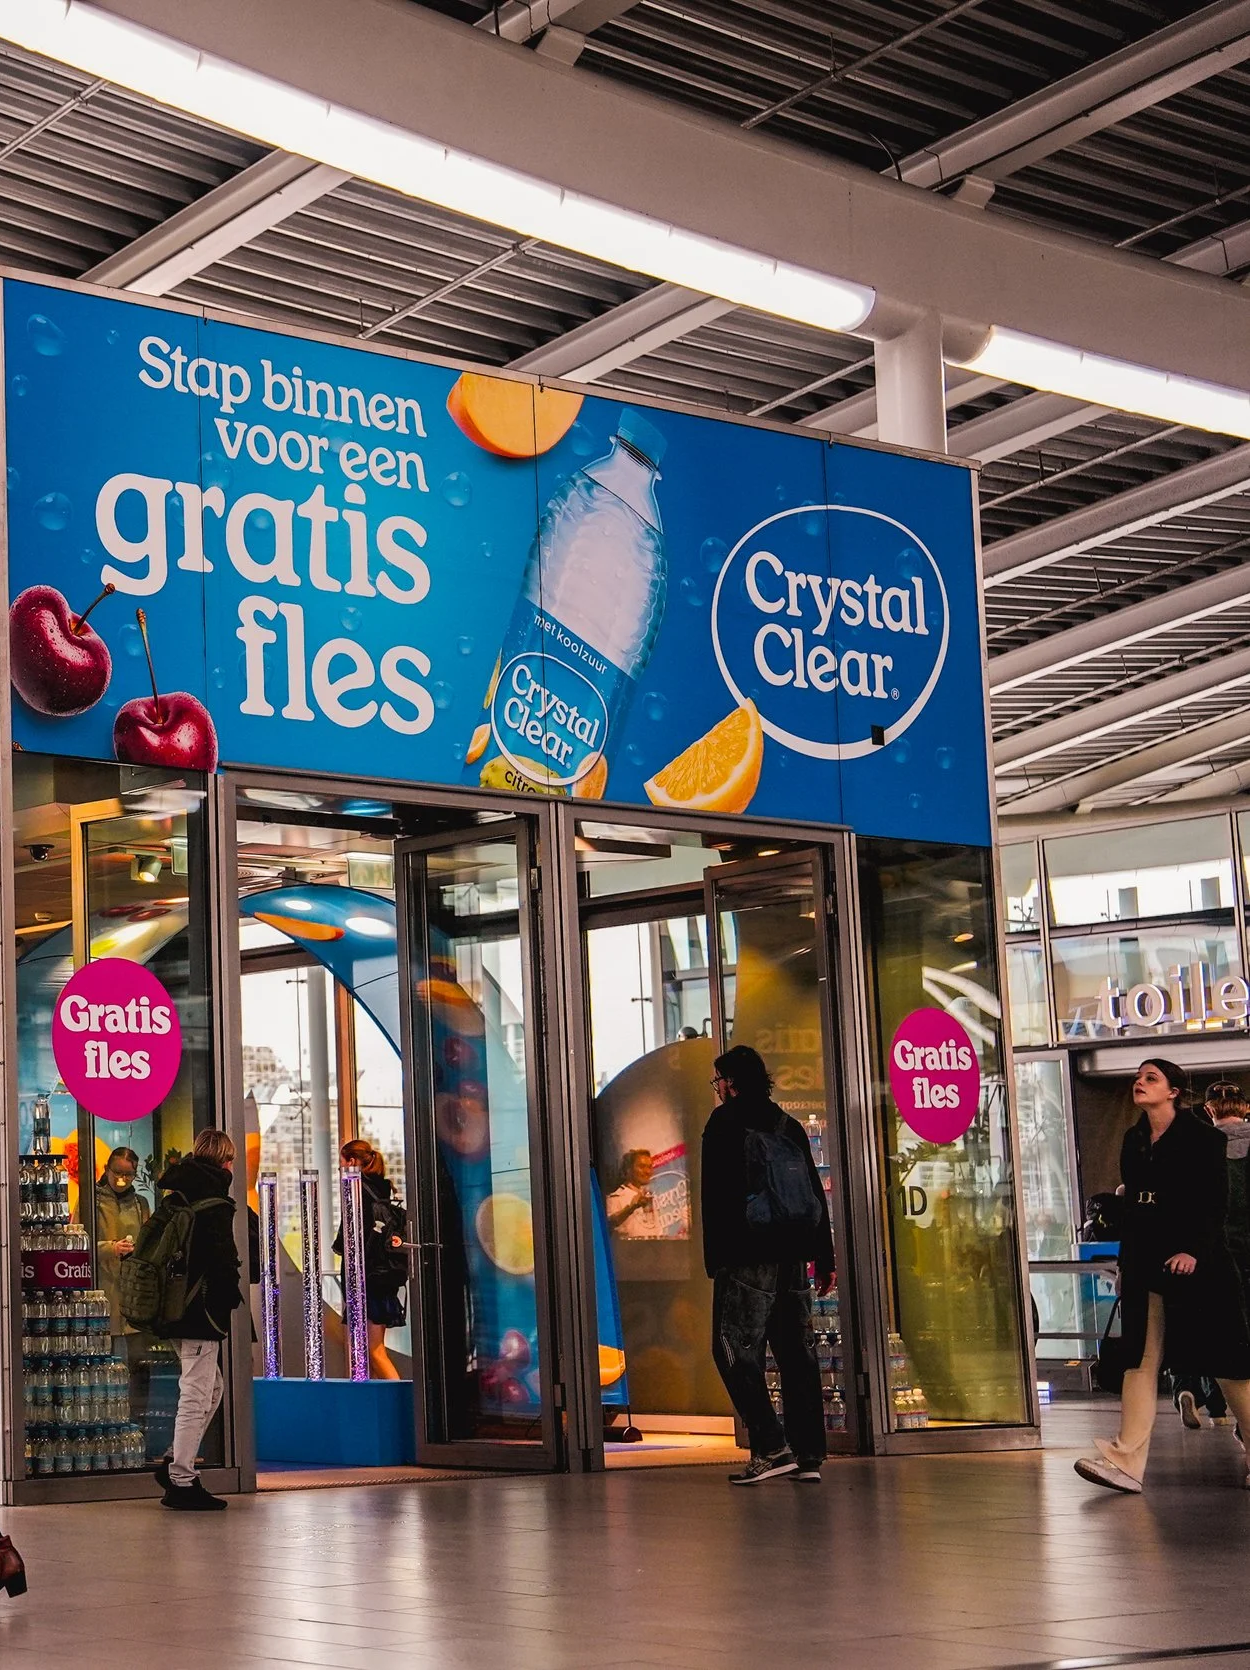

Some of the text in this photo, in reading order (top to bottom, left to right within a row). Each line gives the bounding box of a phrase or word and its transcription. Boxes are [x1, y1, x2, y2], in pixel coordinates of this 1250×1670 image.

[137, 336, 428, 438] Stap binnen
[214, 417, 430, 493] voor een
[95, 473, 431, 605] gratis
[745, 550, 930, 637] Crystal
[236, 595, 435, 735] fles
[533, 613, 608, 675] met koolzuur
[511, 664, 600, 748] Crystal
[60, 994, 172, 1035] Gratis
[84, 1040, 151, 1080] fles
[893, 1038, 972, 1071] Gratis
[912, 1076, 960, 1109] fles
[53, 1260, 92, 1279] Gratis
